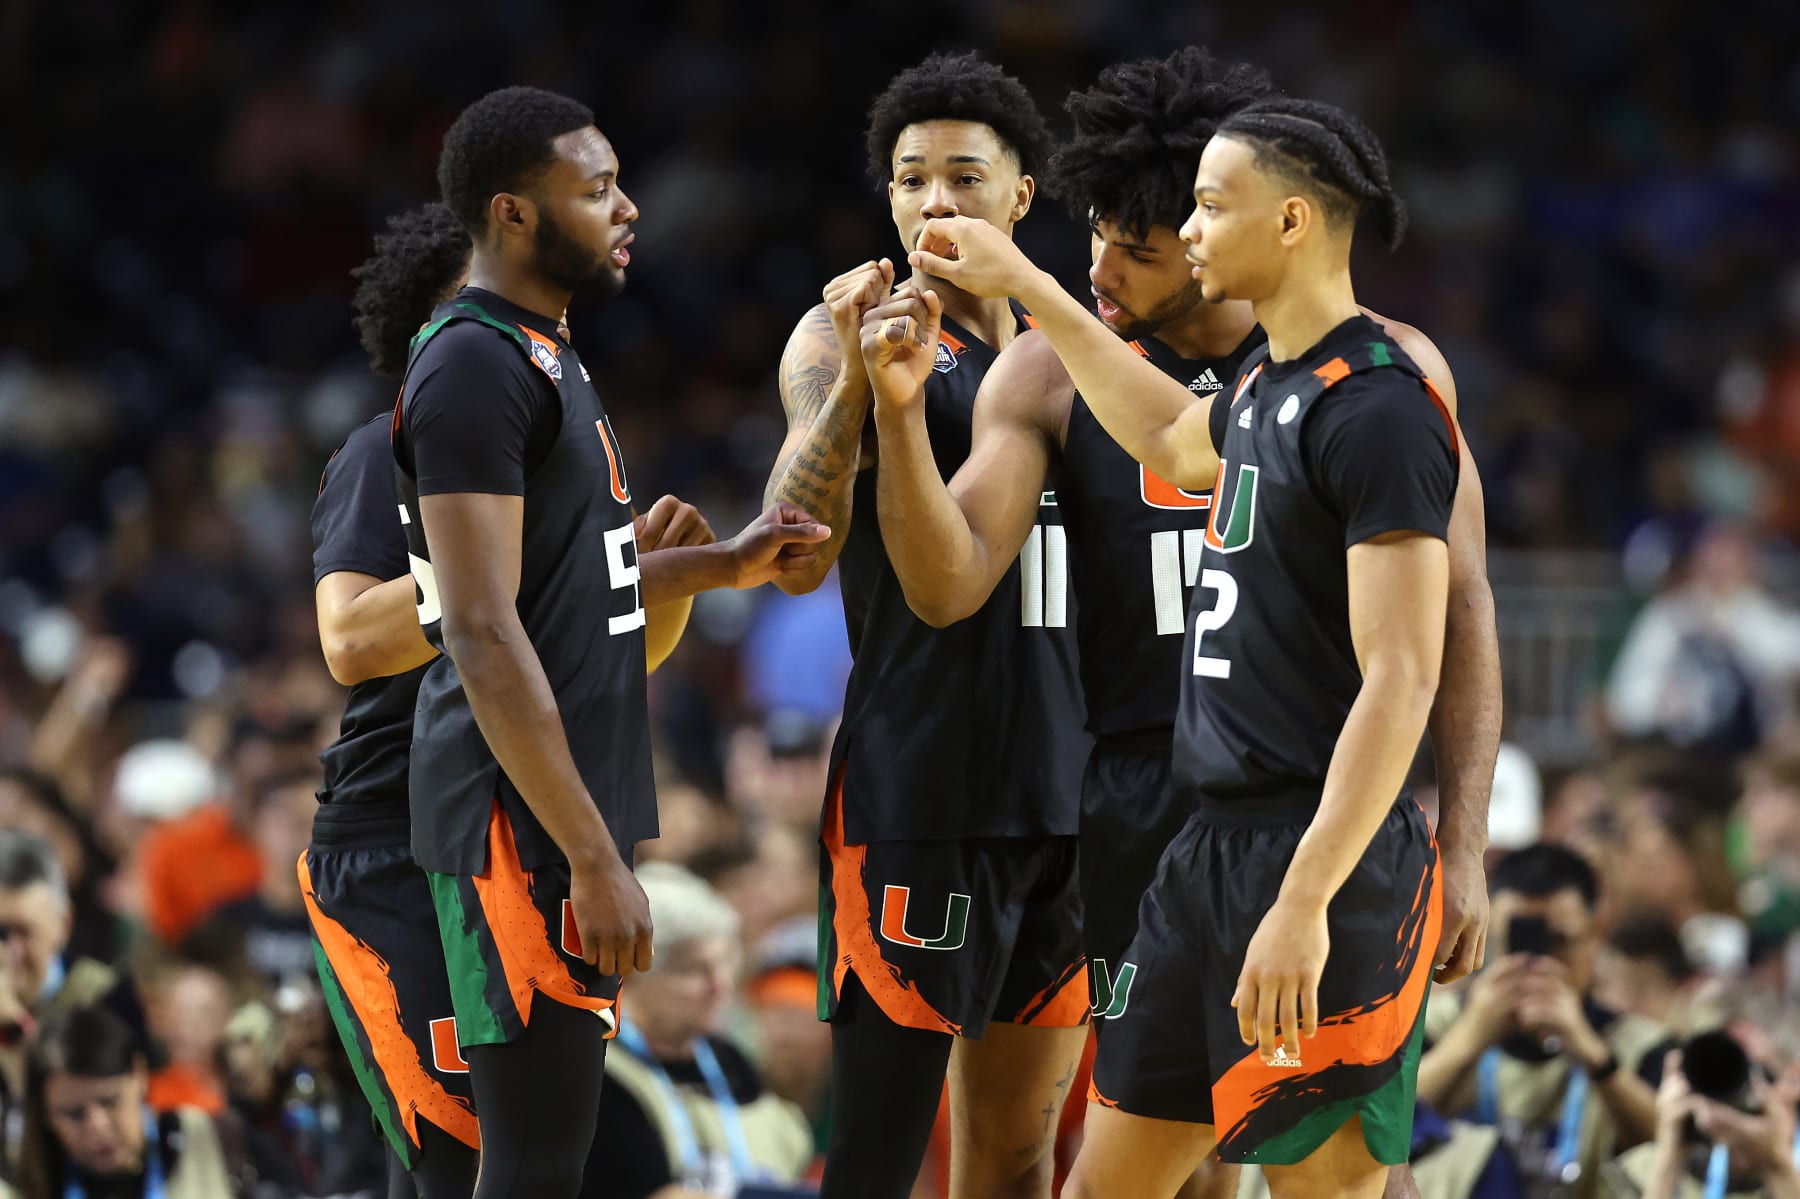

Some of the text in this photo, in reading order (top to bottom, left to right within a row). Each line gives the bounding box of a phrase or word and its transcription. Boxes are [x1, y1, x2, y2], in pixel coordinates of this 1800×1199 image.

[1188, 382, 1224, 391] adidas
[1204, 459, 1259, 554] U
[1020, 525, 1067, 628] 11
[1193, 568, 1239, 679] 2
[881, 885, 971, 950] U
